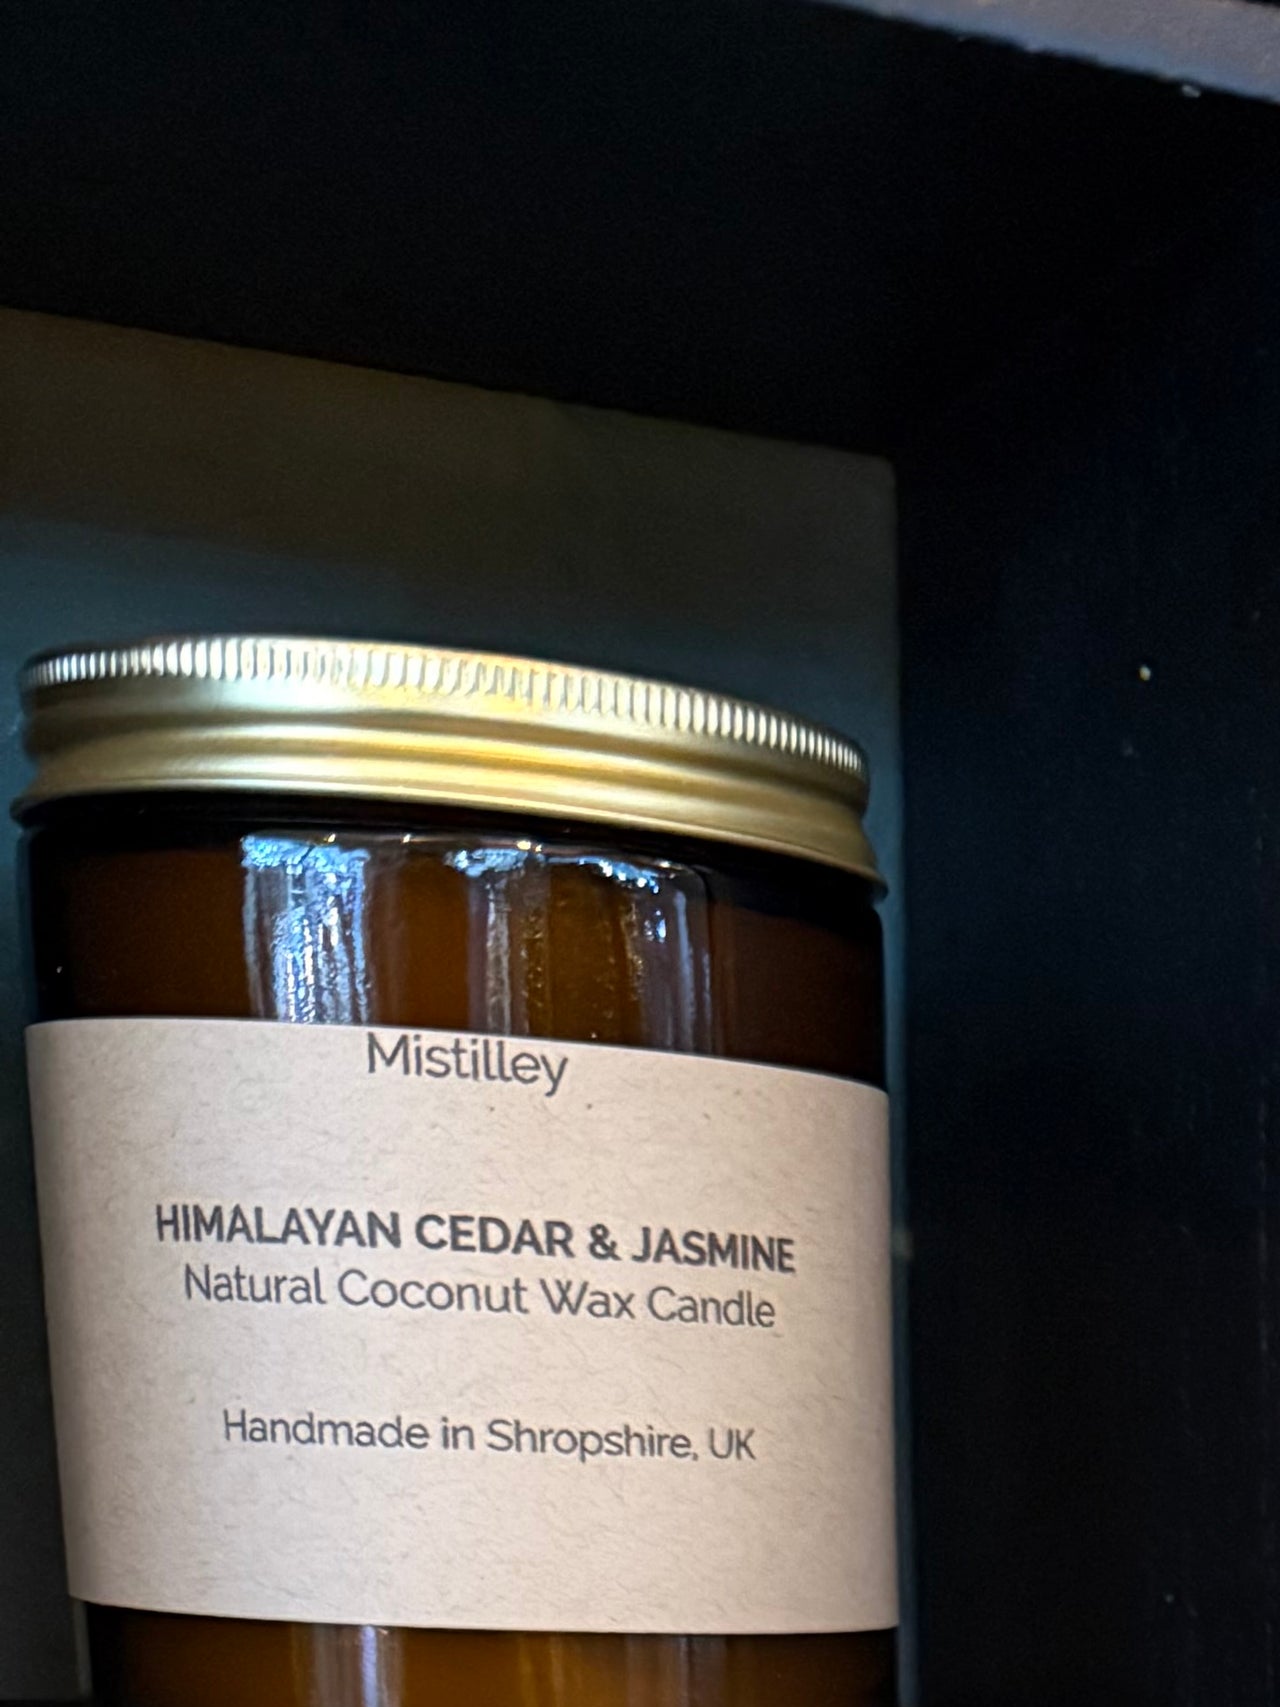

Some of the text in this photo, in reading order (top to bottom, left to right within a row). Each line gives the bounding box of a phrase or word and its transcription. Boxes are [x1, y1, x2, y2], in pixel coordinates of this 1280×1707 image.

[367, 1032, 568, 1096] Mistilley
[155, 1204, 796, 1274] HIMALAYAN CEDAR & JASMINE
[184, 1263, 777, 1329] Natural Coconut Wax Candle
[223, 1410, 757, 1463] Handmade in Shropshire, UK
